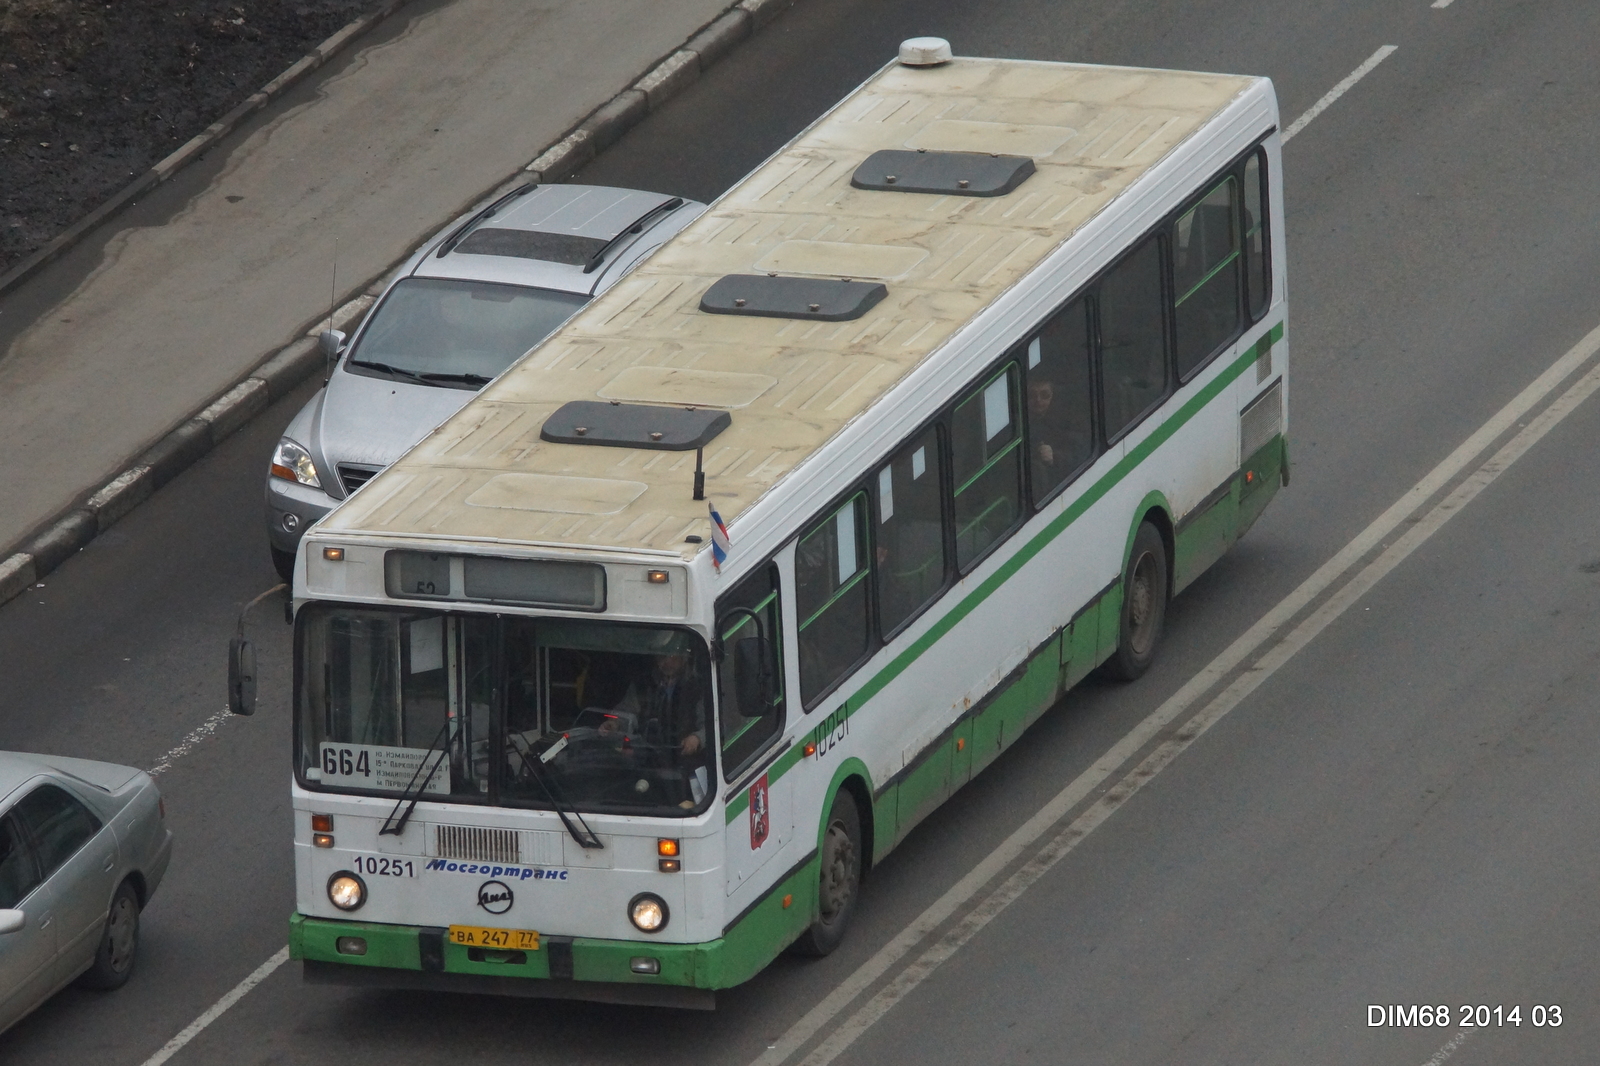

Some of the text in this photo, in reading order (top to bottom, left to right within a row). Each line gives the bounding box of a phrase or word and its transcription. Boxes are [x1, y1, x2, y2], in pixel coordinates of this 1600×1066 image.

[814, 700, 849, 761] 10251
[322, 747, 371, 777] 664
[354, 856, 414, 878] 10251
[426, 858, 569, 881] Мосгортранс
[457, 930, 534, 946] ВА 247 77
